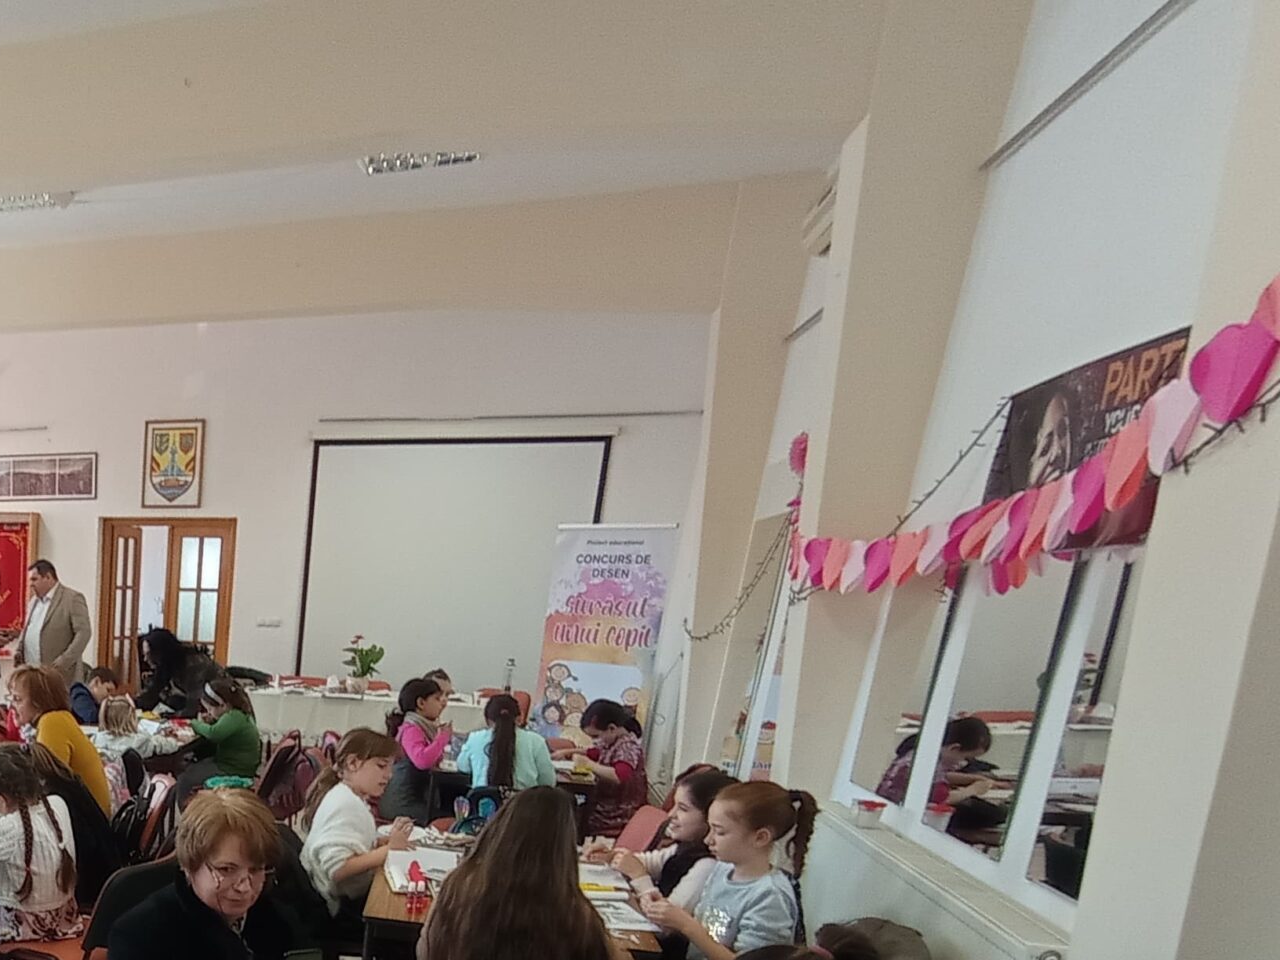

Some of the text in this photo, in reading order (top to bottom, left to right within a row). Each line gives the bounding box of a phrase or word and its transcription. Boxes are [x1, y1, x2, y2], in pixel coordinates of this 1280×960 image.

[576, 554, 652, 565] CONCURS DE
[592, 568, 631, 578] DESEN
